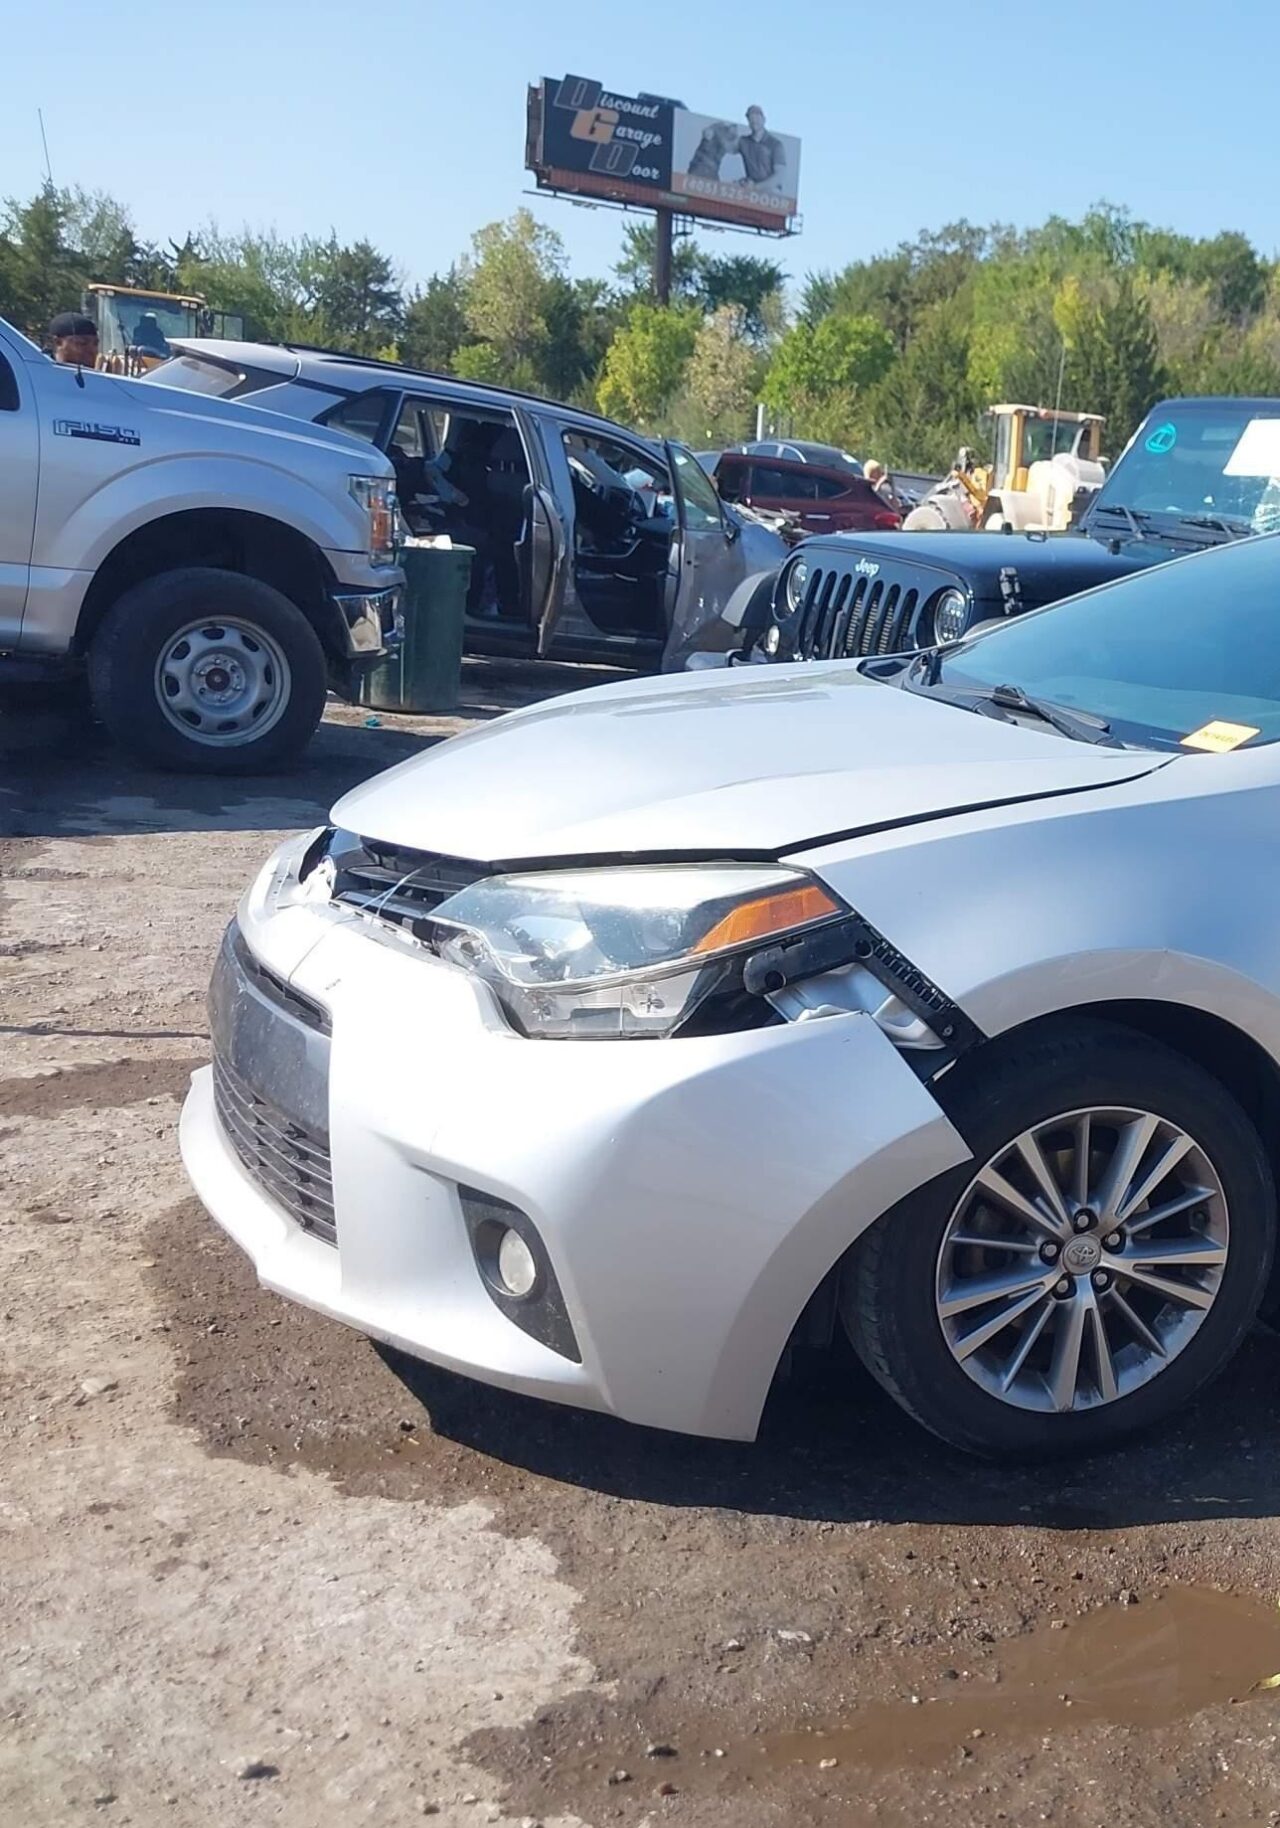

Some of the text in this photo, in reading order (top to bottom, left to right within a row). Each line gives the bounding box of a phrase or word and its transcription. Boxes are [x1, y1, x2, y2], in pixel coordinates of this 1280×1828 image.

[554, 74, 659, 118] Discount
[570, 107, 662, 149] Garage
[588, 139, 659, 179] Door
[855, 557, 880, 577] Jeep
